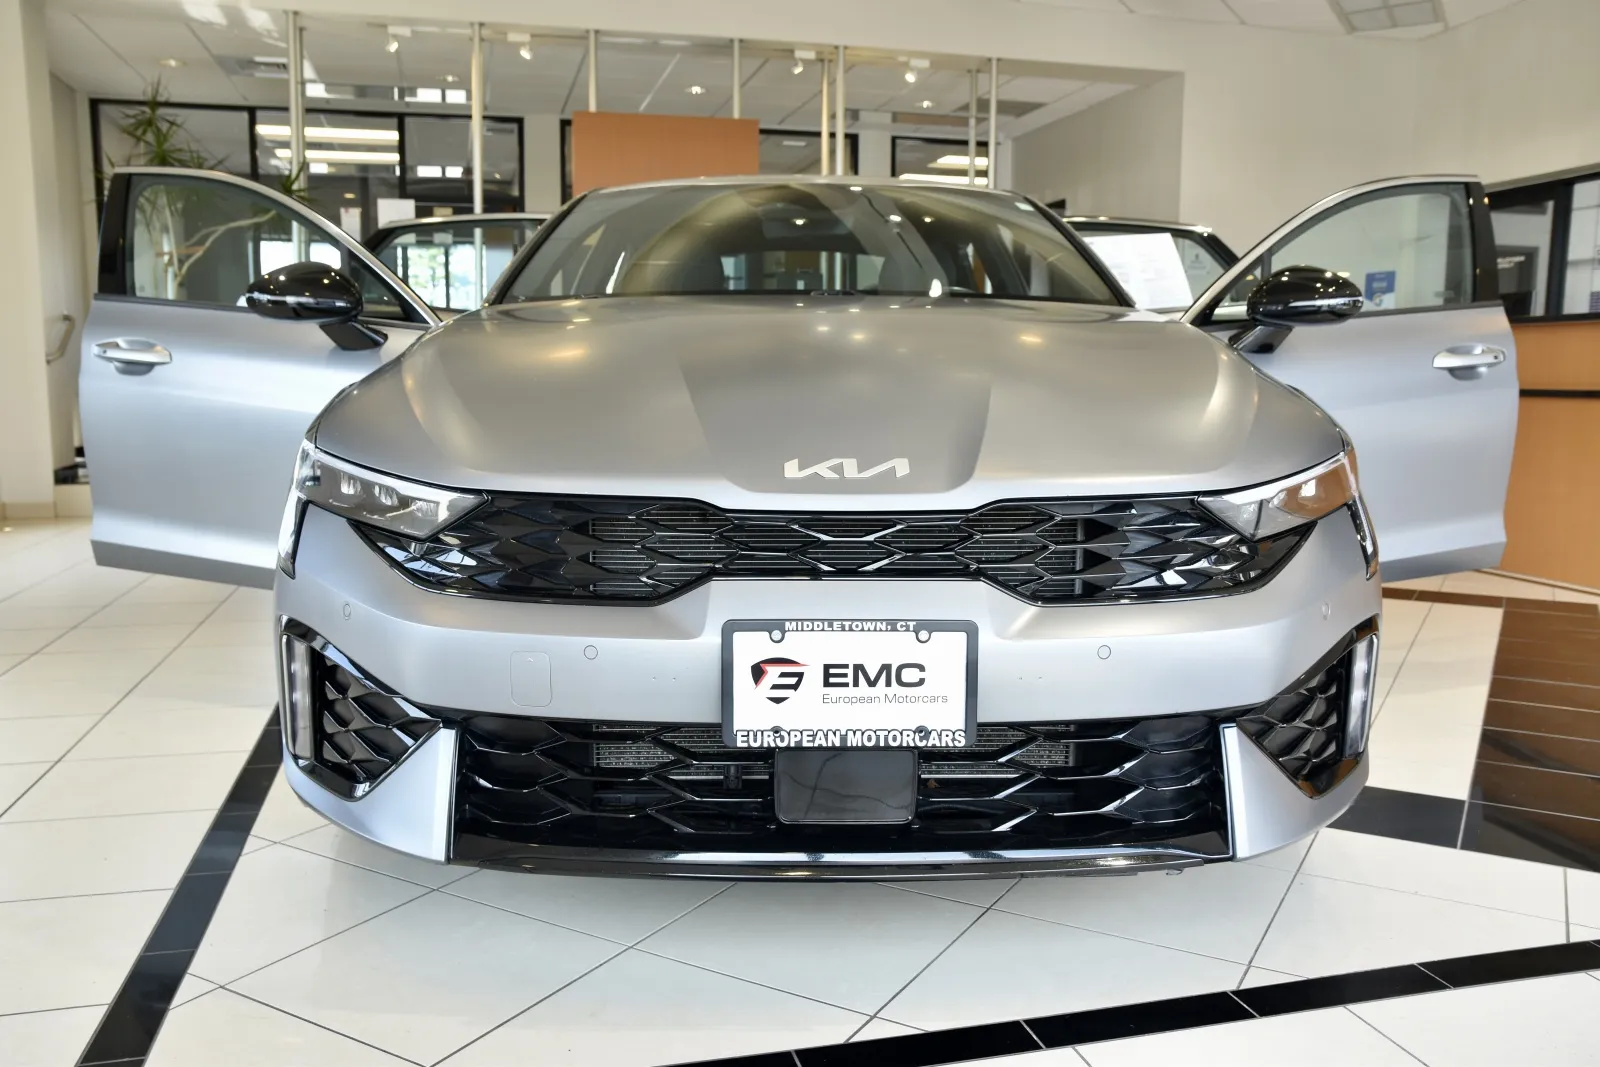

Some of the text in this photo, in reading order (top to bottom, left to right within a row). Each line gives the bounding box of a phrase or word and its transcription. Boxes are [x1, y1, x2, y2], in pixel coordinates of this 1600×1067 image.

[785, 621, 917, 632] MIDDLETOWN, CT
[823, 663, 926, 688] EMC
[822, 693, 948, 706] European Motorcars
[736, 729, 966, 748] EUROPEAN MOTORCARS
